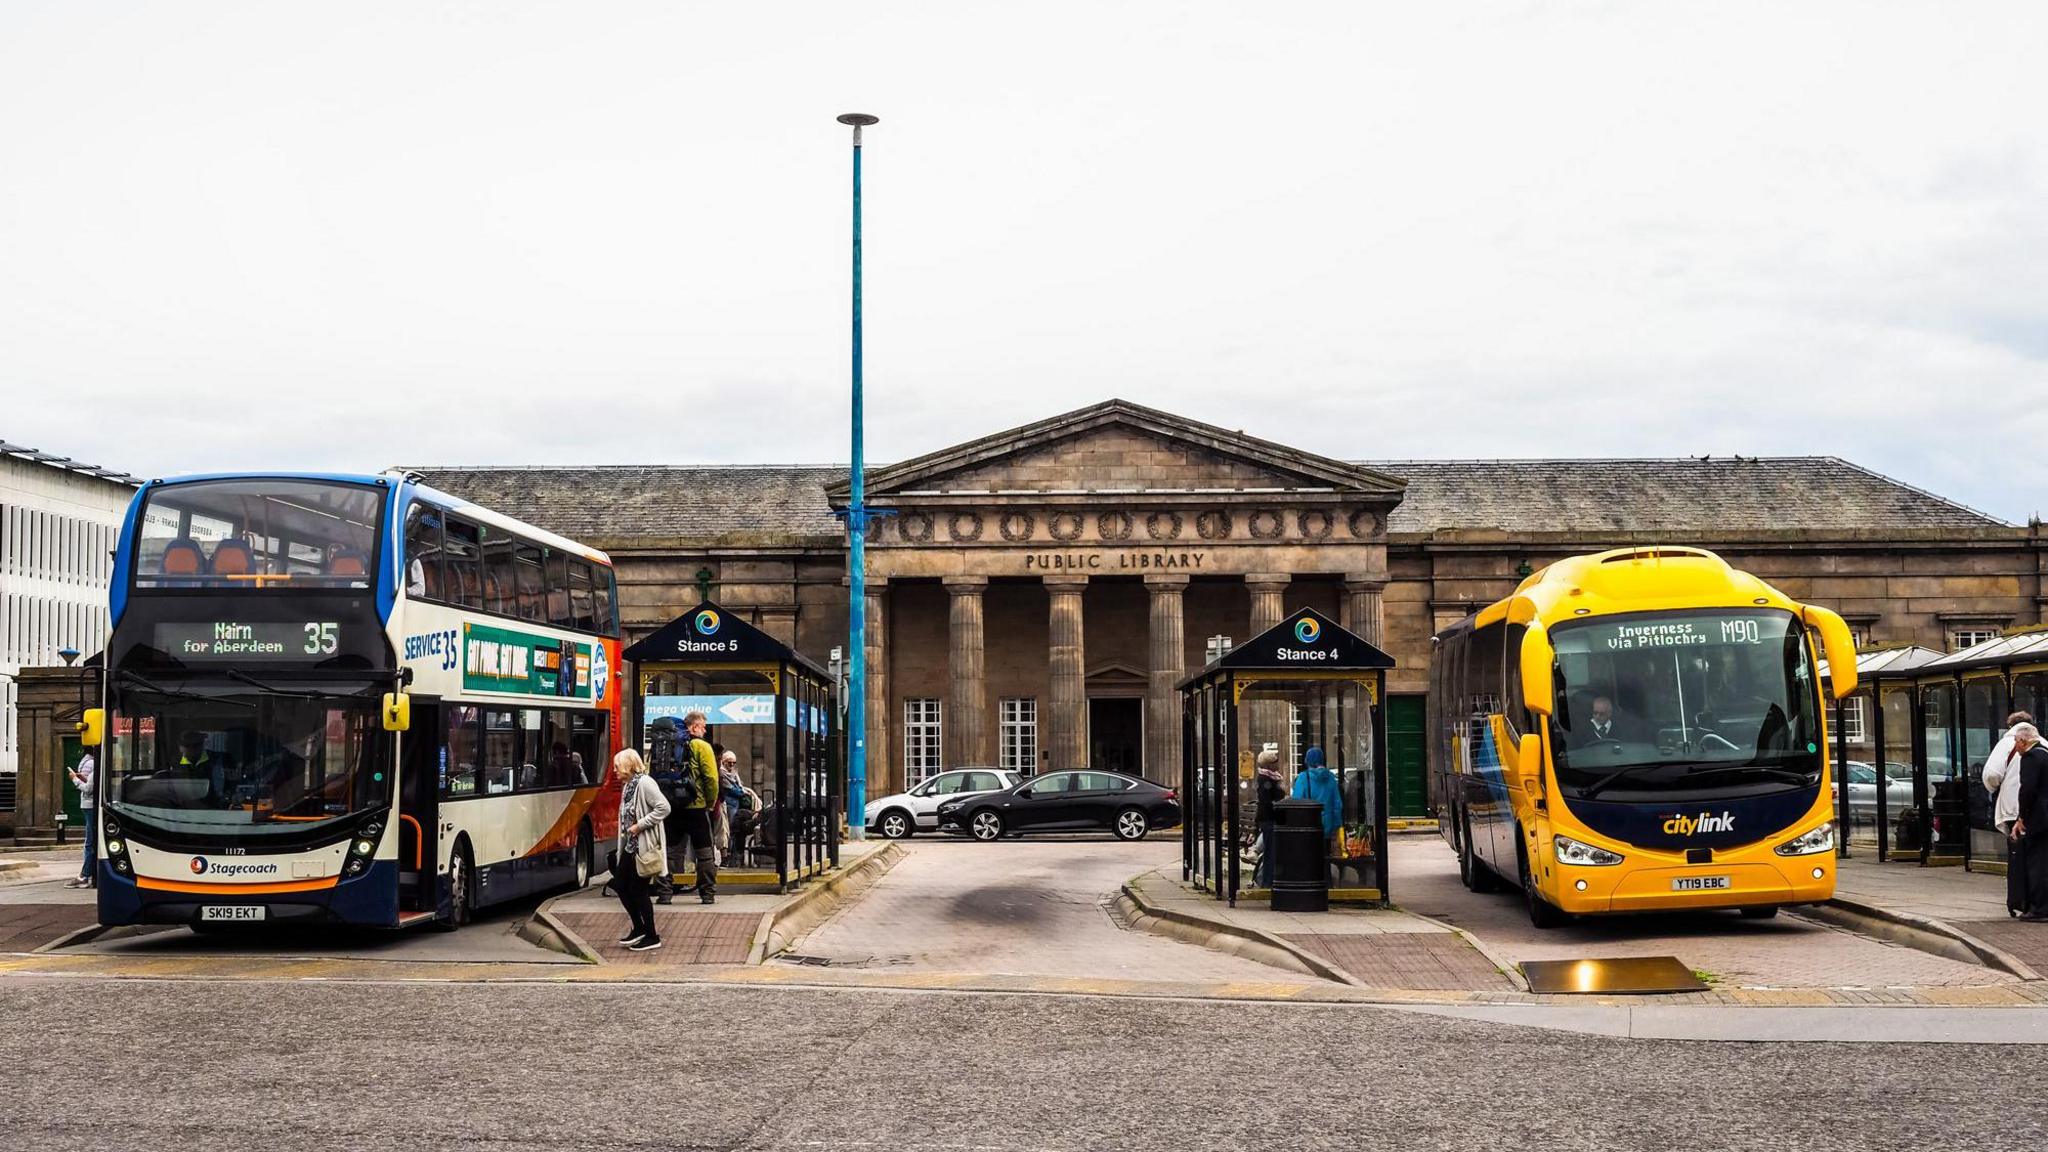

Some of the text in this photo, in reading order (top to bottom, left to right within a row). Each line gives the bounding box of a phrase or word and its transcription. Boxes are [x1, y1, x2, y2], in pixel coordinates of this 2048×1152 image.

[1026, 553, 1204, 569] PUBLIC LIBRARY
[215, 622, 252, 639] Nairn
[1618, 624, 1693, 638] Inverness
[303, 622, 339, 654] 35
[1608, 632, 1707, 649] Via Pitlochry
[184, 640, 283, 653] for Aberdeen
[405, 632, 442, 661] SERVICE
[442, 630, 457, 671] 35
[678, 640, 738, 652] Stance 5
[1277, 648, 1339, 660] Stance 4
[646, 703, 712, 717] mega value
[1663, 811, 1736, 836] citylink
[225, 847, 246, 856] 11172
[210, 863, 277, 876] Stagecoach
[1677, 877, 1725, 889] YT19 EBC
[208, 907, 258, 919] SK19 EKT
